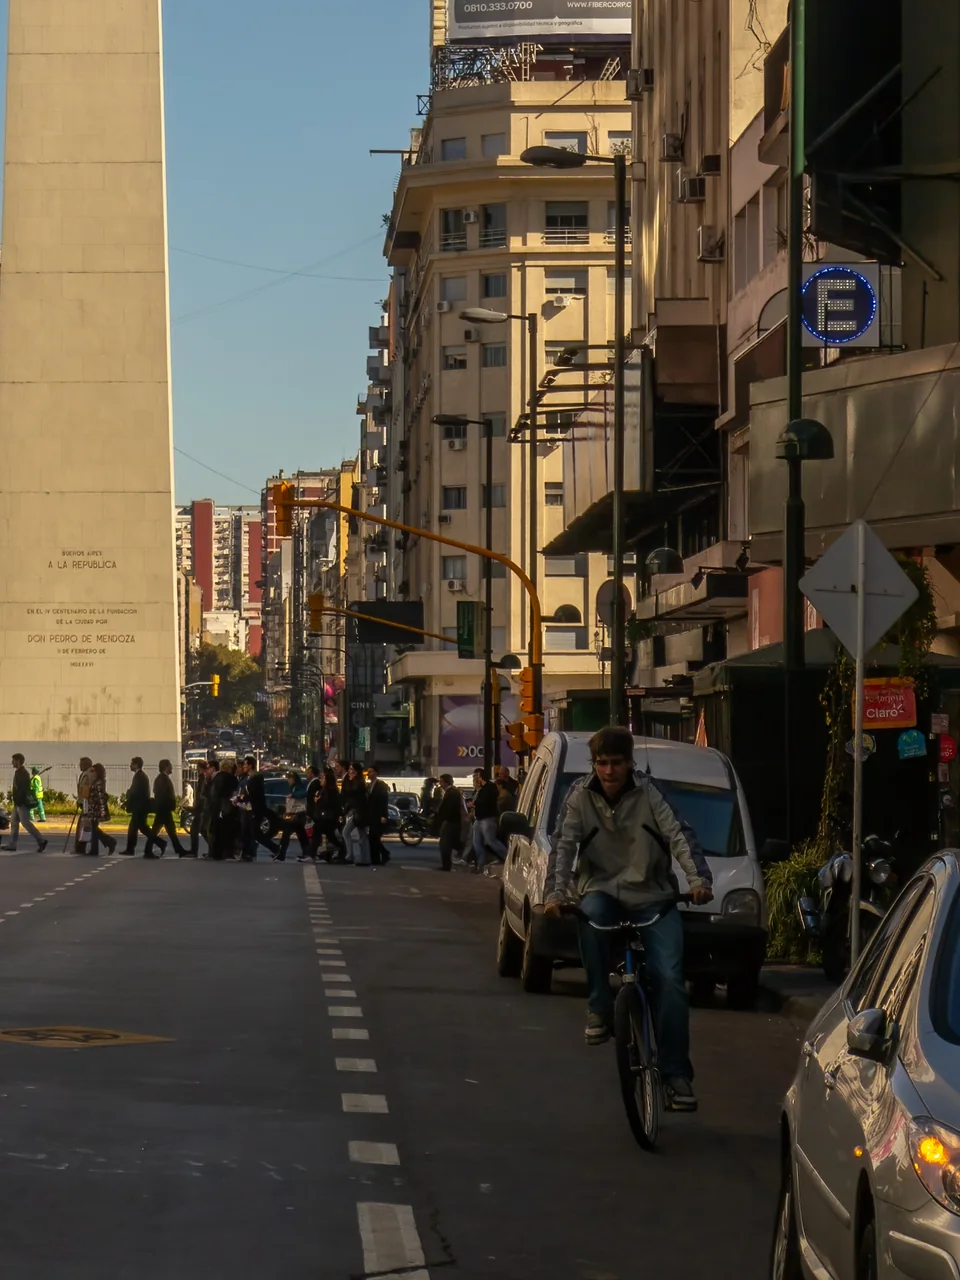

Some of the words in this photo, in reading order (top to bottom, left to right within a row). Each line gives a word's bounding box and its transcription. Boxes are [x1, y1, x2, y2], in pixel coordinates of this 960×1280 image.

[464, 1, 533, 12] 0810.333.0700
[818, 280, 857, 331] E
[48, 560, 53, 569] A
[57, 560, 68, 569] LA
[72, 560, 117, 569] REPUBLICA
[27, 634, 46, 643] DON
[49, 634, 78, 643] PEDRO
[82, 634, 92, 643] DE
[96, 634, 136, 643] MENDOZA
[866, 708, 898, 719] Claro
